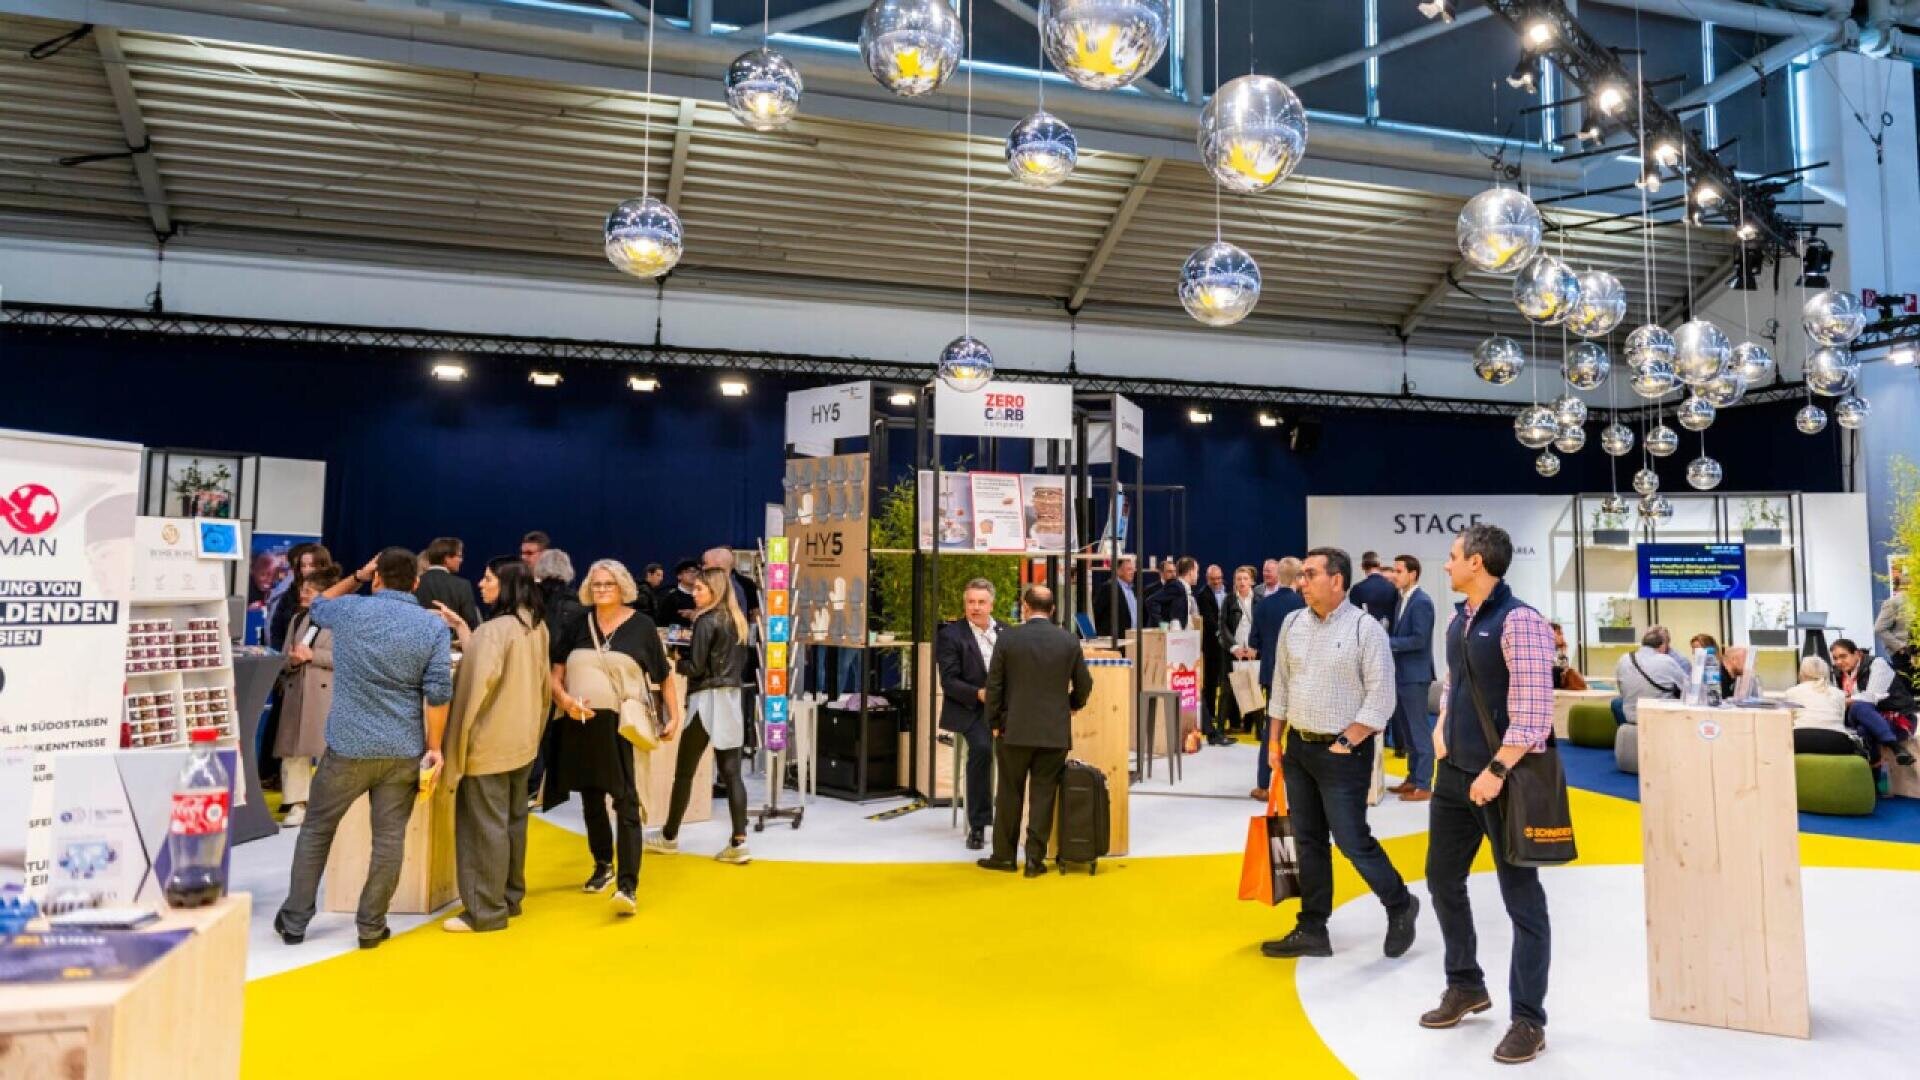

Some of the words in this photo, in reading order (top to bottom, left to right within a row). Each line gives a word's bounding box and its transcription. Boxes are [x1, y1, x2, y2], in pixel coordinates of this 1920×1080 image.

[985, 393, 1024, 407] ZERO
[811, 402, 840, 424] HY5
[984, 408, 1024, 421] CARB
[0, 537, 57, 556] MAN
[806, 531, 843, 556] HY5
[0, 581, 37, 595] UNG
[41, 581, 78, 595] VON
[0, 602, 113, 622] DENDEN
[31, 718, 108, 732] SÜDOSTASIEN
